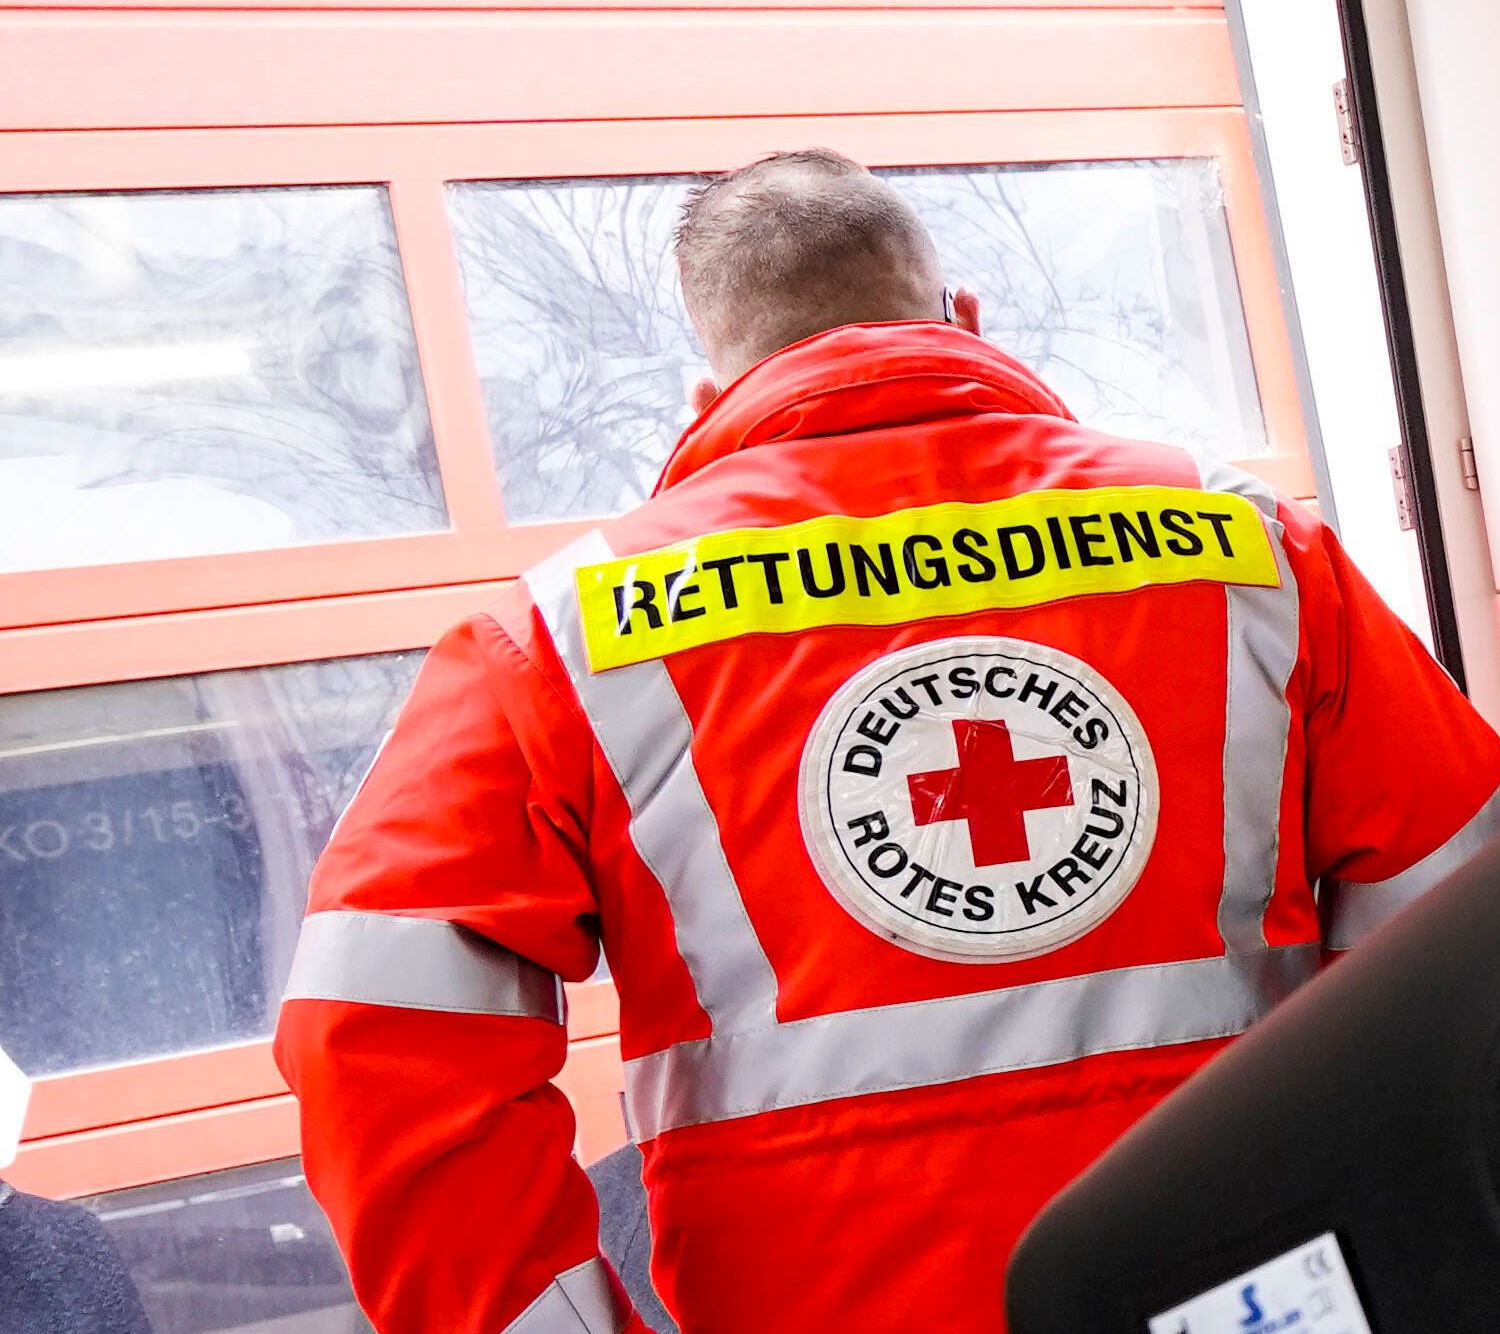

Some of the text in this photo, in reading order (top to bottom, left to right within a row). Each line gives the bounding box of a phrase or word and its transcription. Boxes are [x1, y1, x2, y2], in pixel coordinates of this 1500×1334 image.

[612, 509, 1237, 637] RETTUNGSDIENST
[843, 665, 1111, 778] DEUTSCHES
[847, 777, 1128, 922] ROTES KREUZ
